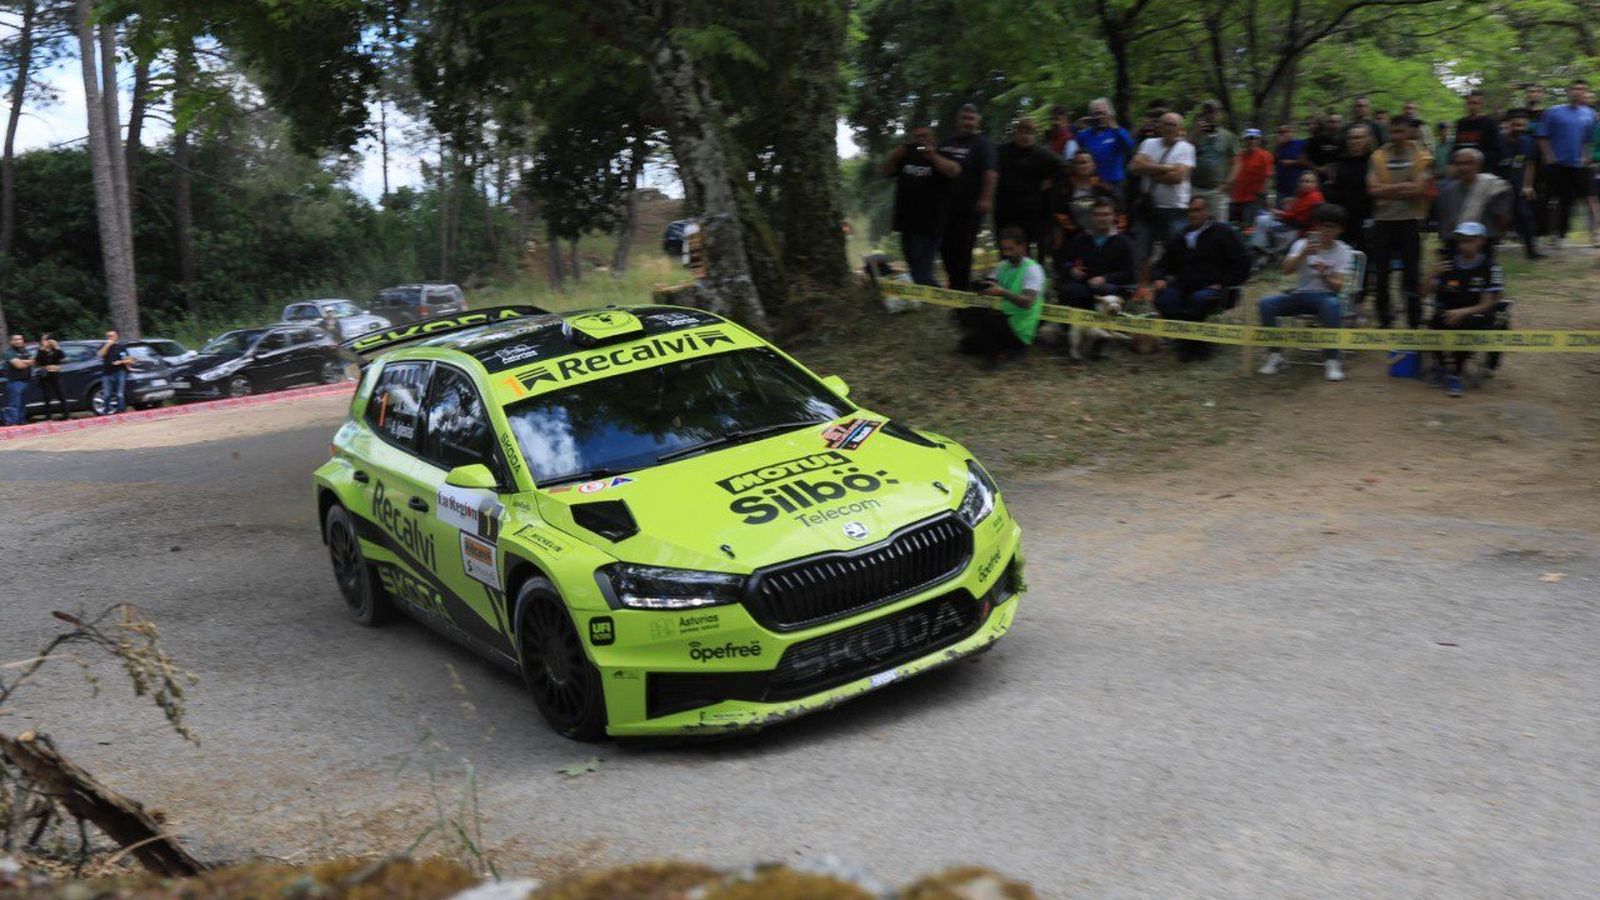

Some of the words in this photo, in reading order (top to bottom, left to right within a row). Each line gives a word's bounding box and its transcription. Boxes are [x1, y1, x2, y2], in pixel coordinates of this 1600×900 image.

[502, 374, 525, 398] 1
[556, 333, 699, 381] Recalvi
[728, 454, 844, 493] MOTUL
[372, 479, 437, 574] Recalvi
[794, 498, 881, 528] Telecom
[679, 613, 719, 627] Asturias
[792, 602, 966, 676] SKODA
